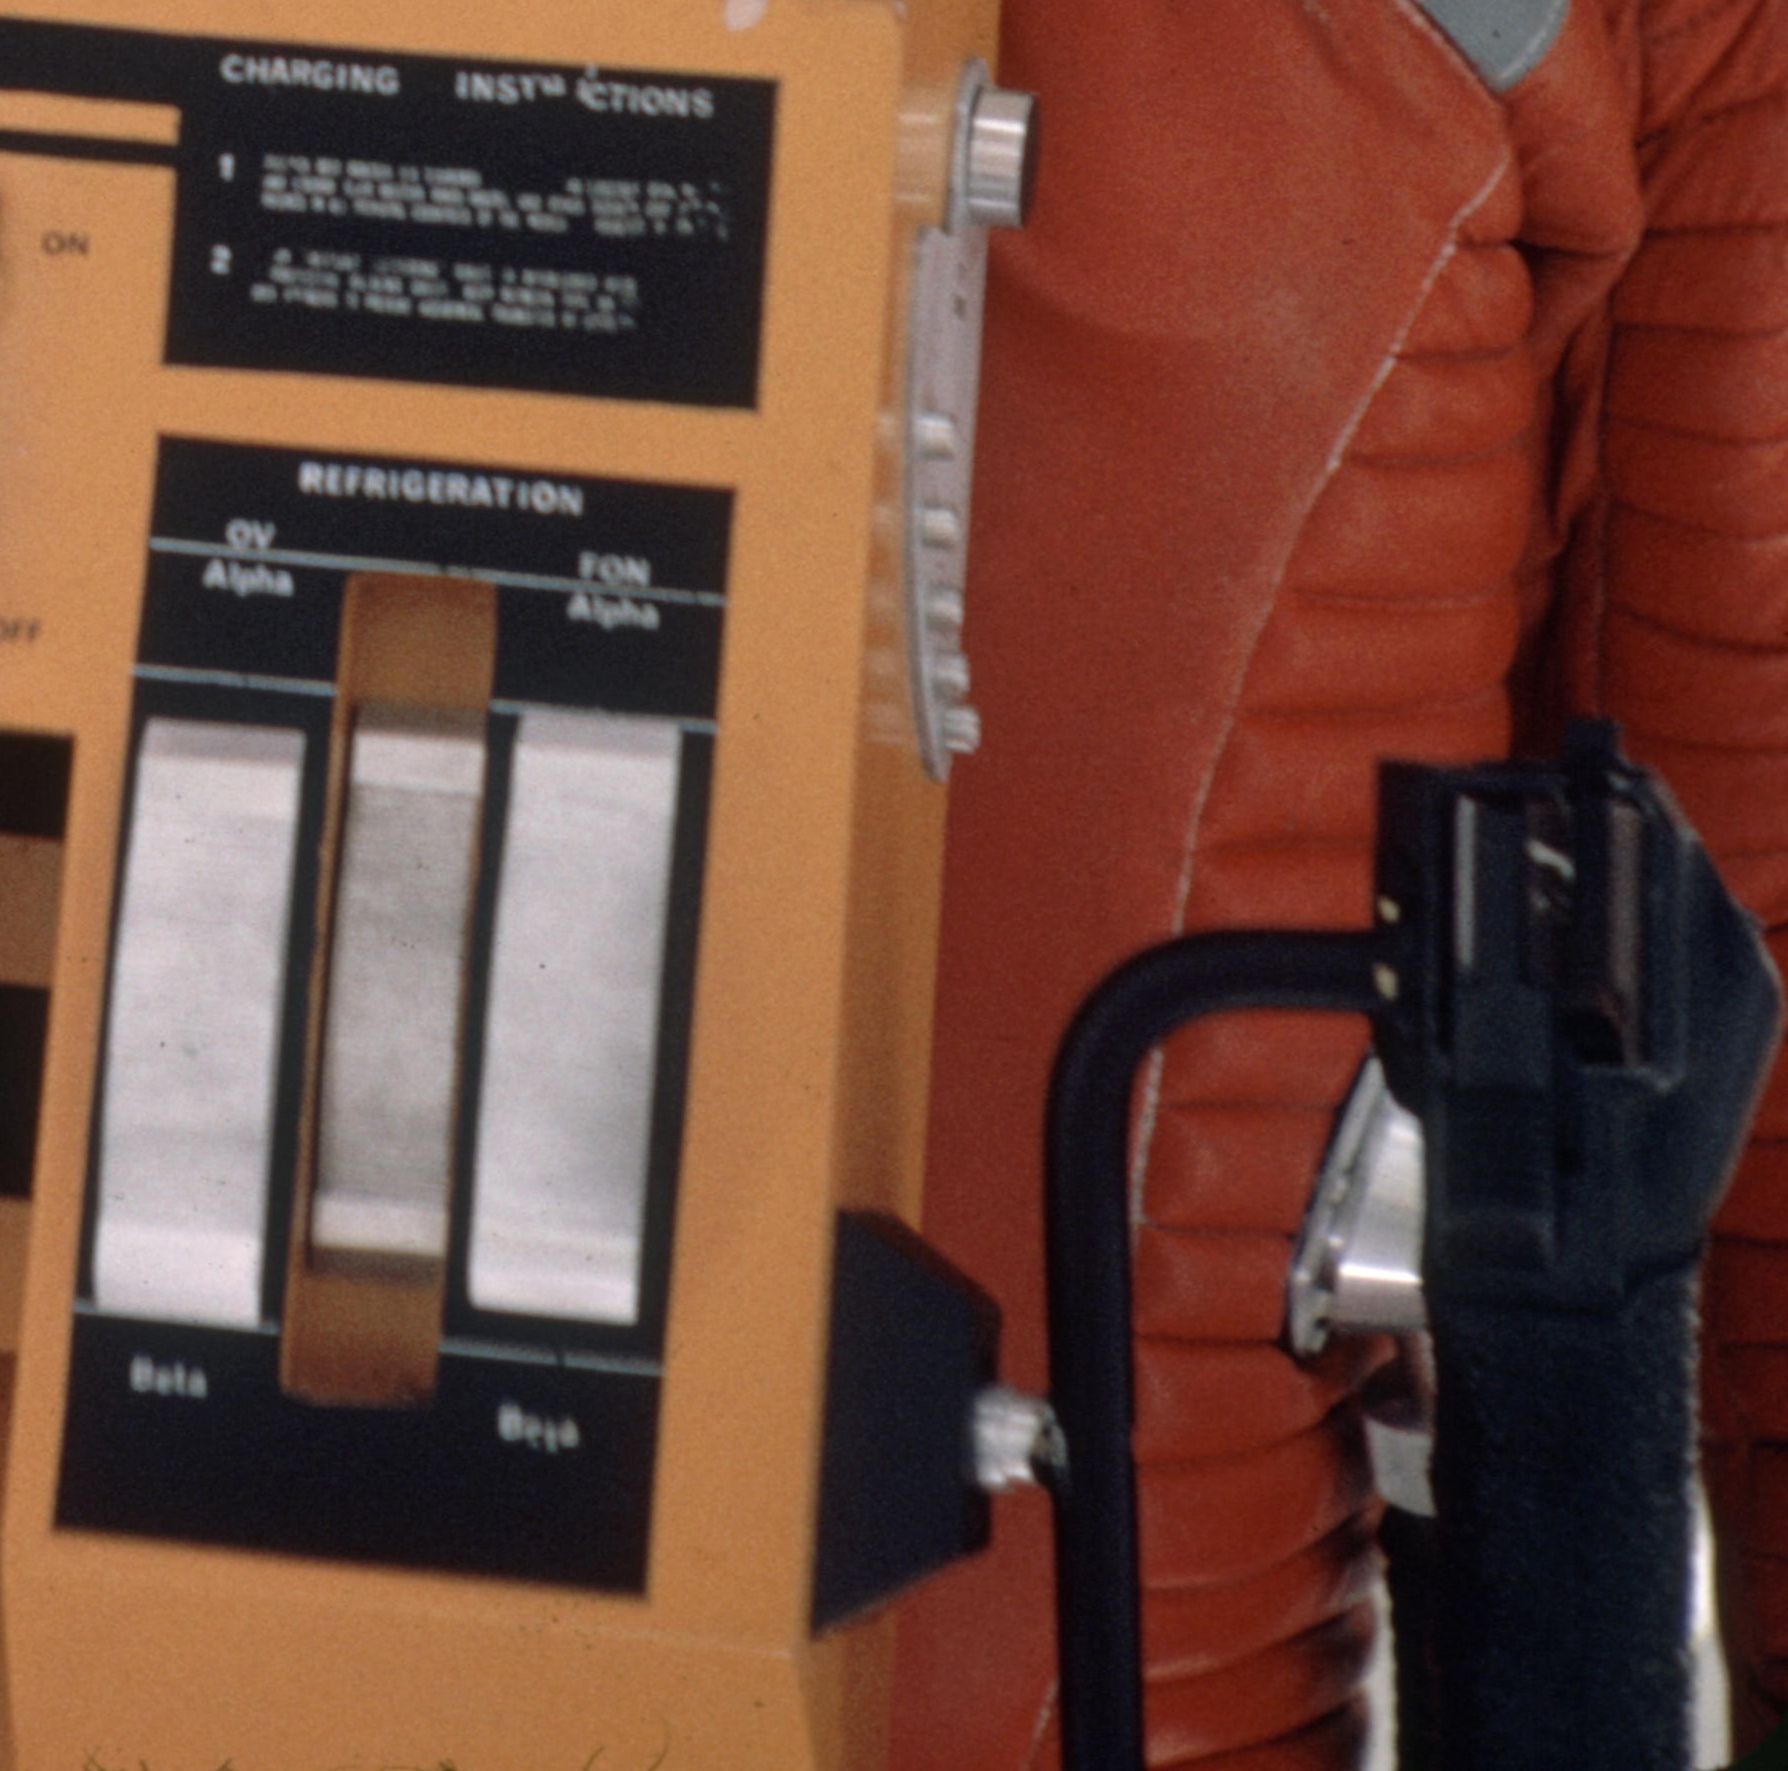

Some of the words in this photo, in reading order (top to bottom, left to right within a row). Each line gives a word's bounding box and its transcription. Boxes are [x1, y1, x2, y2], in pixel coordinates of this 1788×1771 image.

[220, 55, 401, 96] CHARGING
[41, 230, 89, 257] ON
[211, 245, 232, 274] 2
[299, 461, 585, 516] REFRIGERATION
[202, 558, 295, 598] Alpha
[567, 591, 661, 631] Alpha
